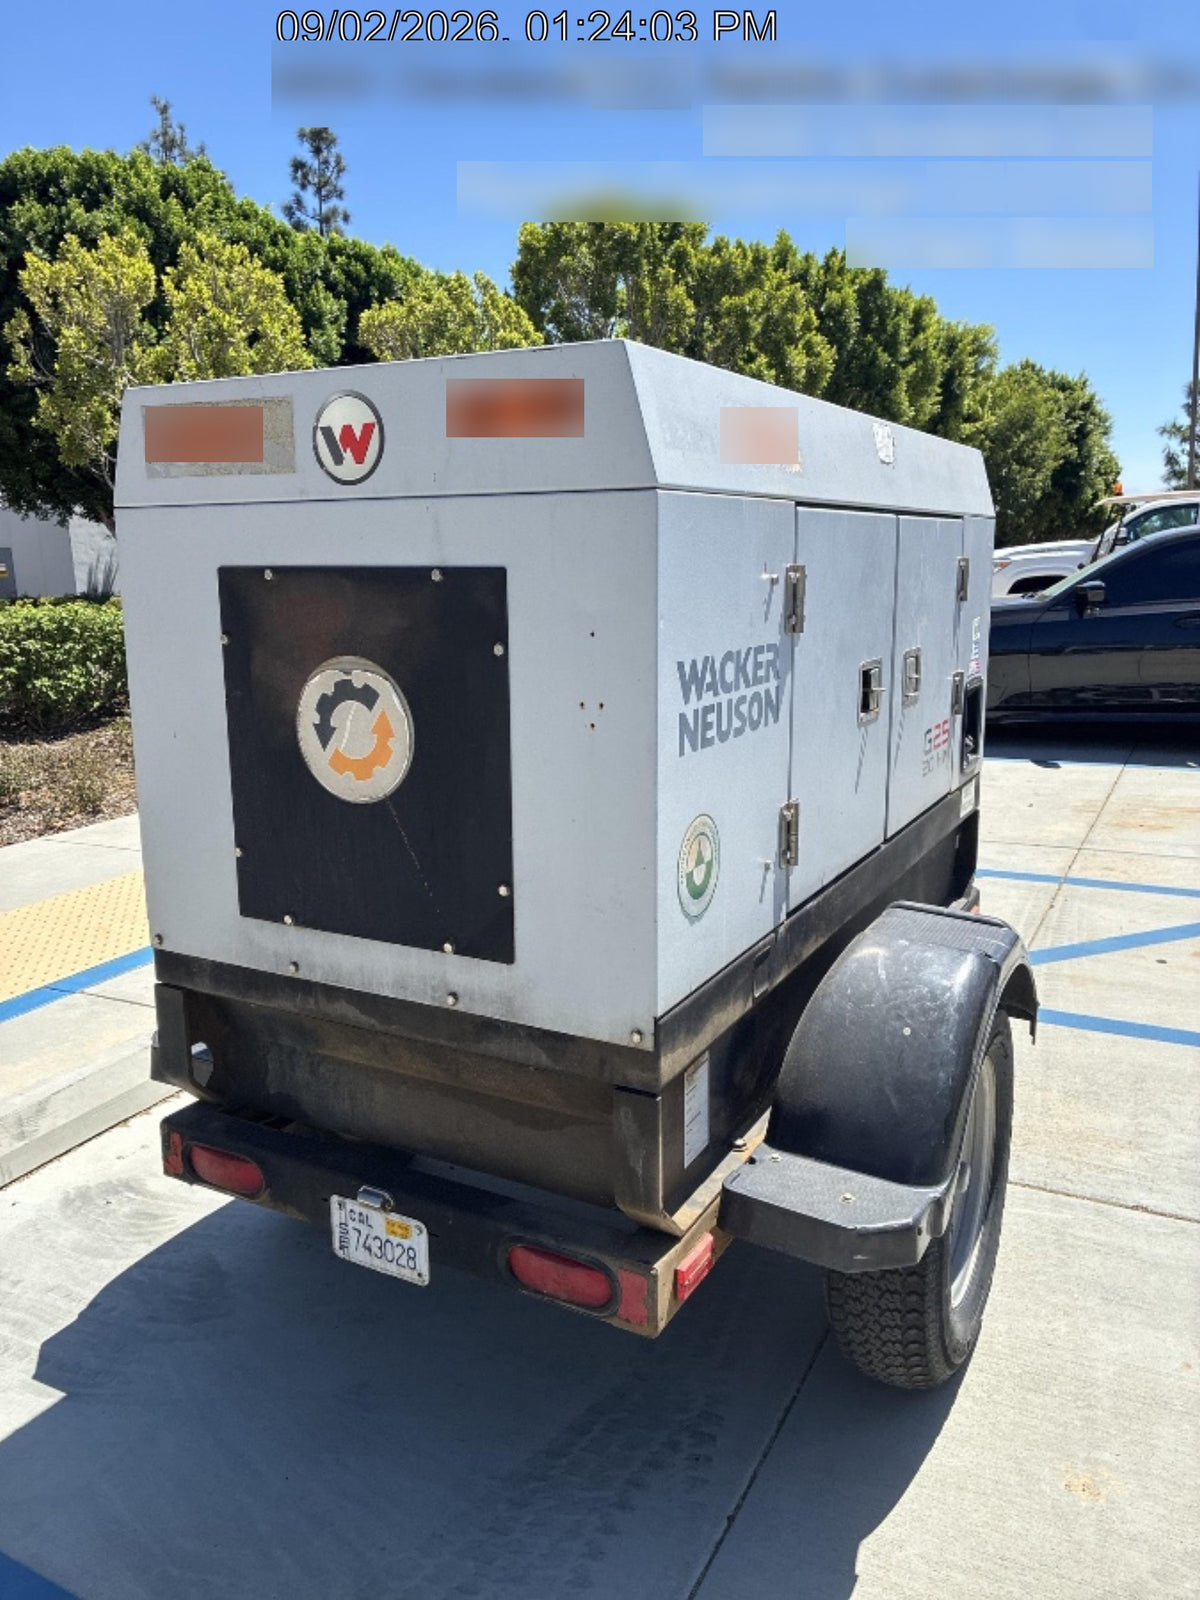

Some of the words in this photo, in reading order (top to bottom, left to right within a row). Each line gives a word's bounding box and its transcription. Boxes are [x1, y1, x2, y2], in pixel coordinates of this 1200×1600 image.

[677, 643, 780, 705] WACKER
[679, 685, 780, 757] NEUSON
[349, 1208, 374, 1230] CAL
[352, 1226, 417, 1270] 743028
